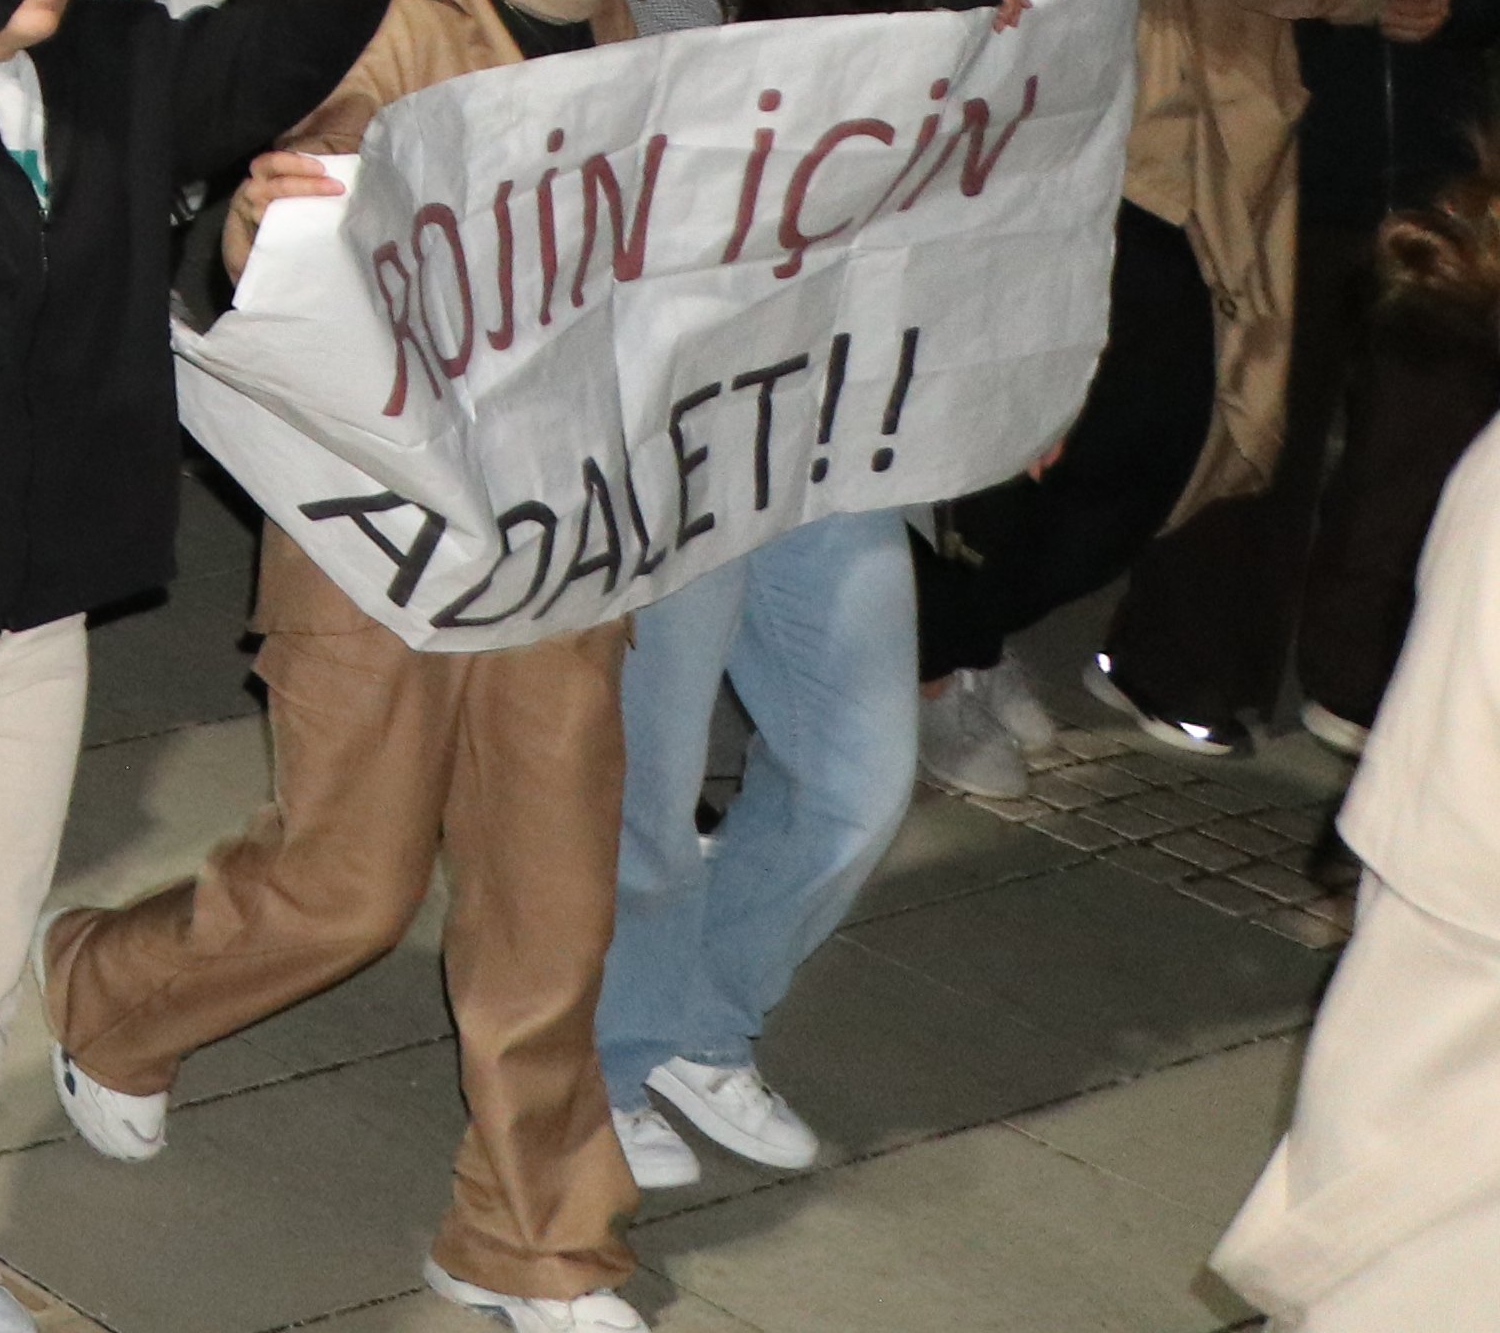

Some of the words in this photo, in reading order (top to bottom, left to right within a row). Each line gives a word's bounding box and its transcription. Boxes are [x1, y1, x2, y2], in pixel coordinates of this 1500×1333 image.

[370, 127, 668, 418] ROJİN
[720, 73, 1039, 278] İÇİN
[298, 328, 919, 629] ADALET!!
